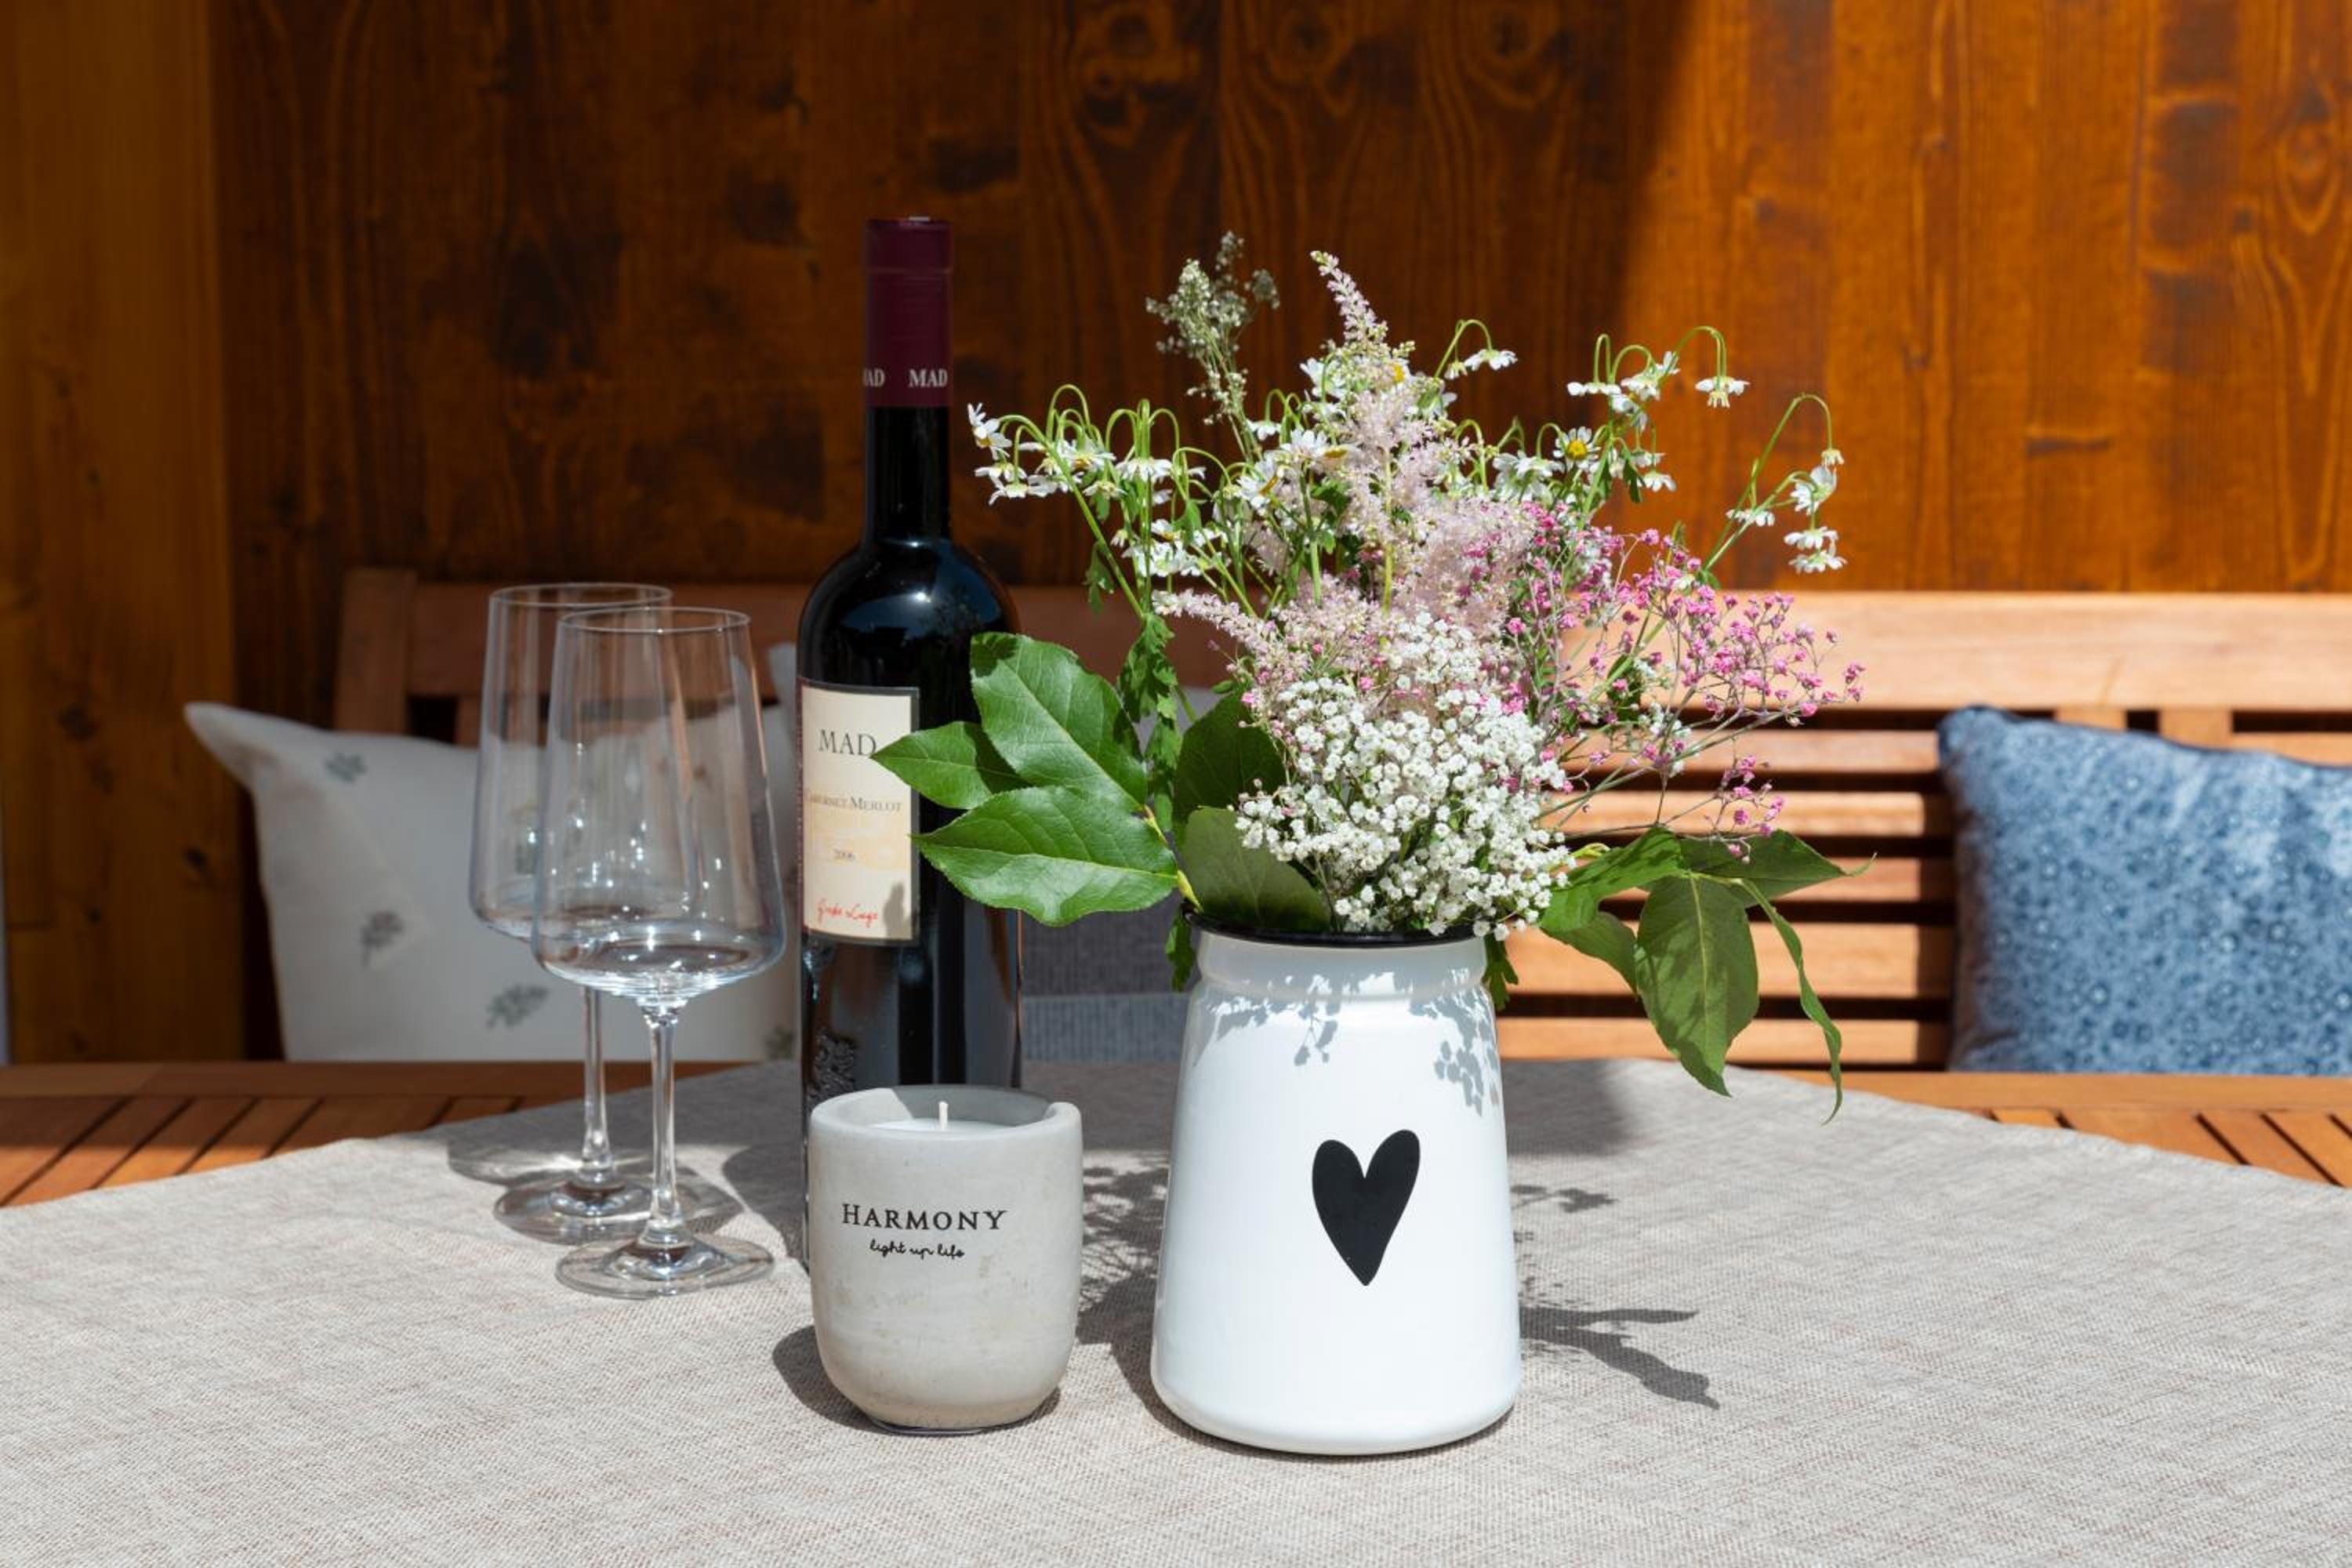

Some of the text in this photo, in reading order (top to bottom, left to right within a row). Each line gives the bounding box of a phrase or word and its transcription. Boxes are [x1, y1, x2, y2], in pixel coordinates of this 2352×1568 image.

[863, 368, 948, 387] AD MAD
[818, 729, 877, 756] MAD
[850, 796, 902, 812] MERLOT
[841, 1203, 1007, 1231] HARMONY
[869, 1238, 965, 1260] light up life
